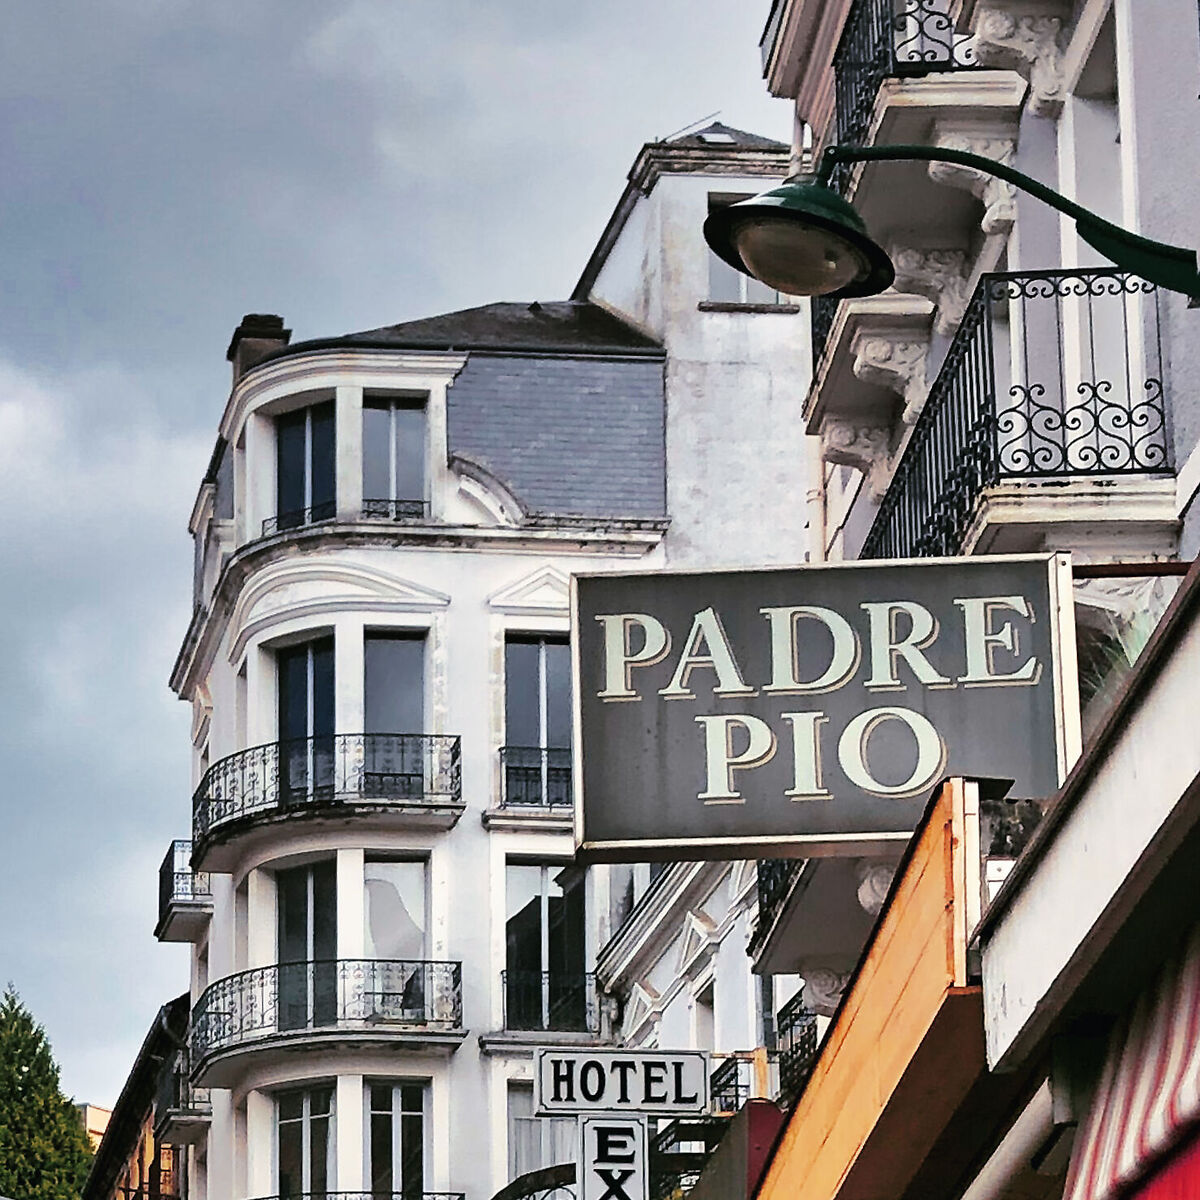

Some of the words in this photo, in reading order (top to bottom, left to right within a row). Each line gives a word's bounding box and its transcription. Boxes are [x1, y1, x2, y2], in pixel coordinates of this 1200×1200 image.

[594, 596, 1044, 703] PADRE
[695, 706, 948, 806] PIO
[550, 1058, 699, 1105] HOTEL
